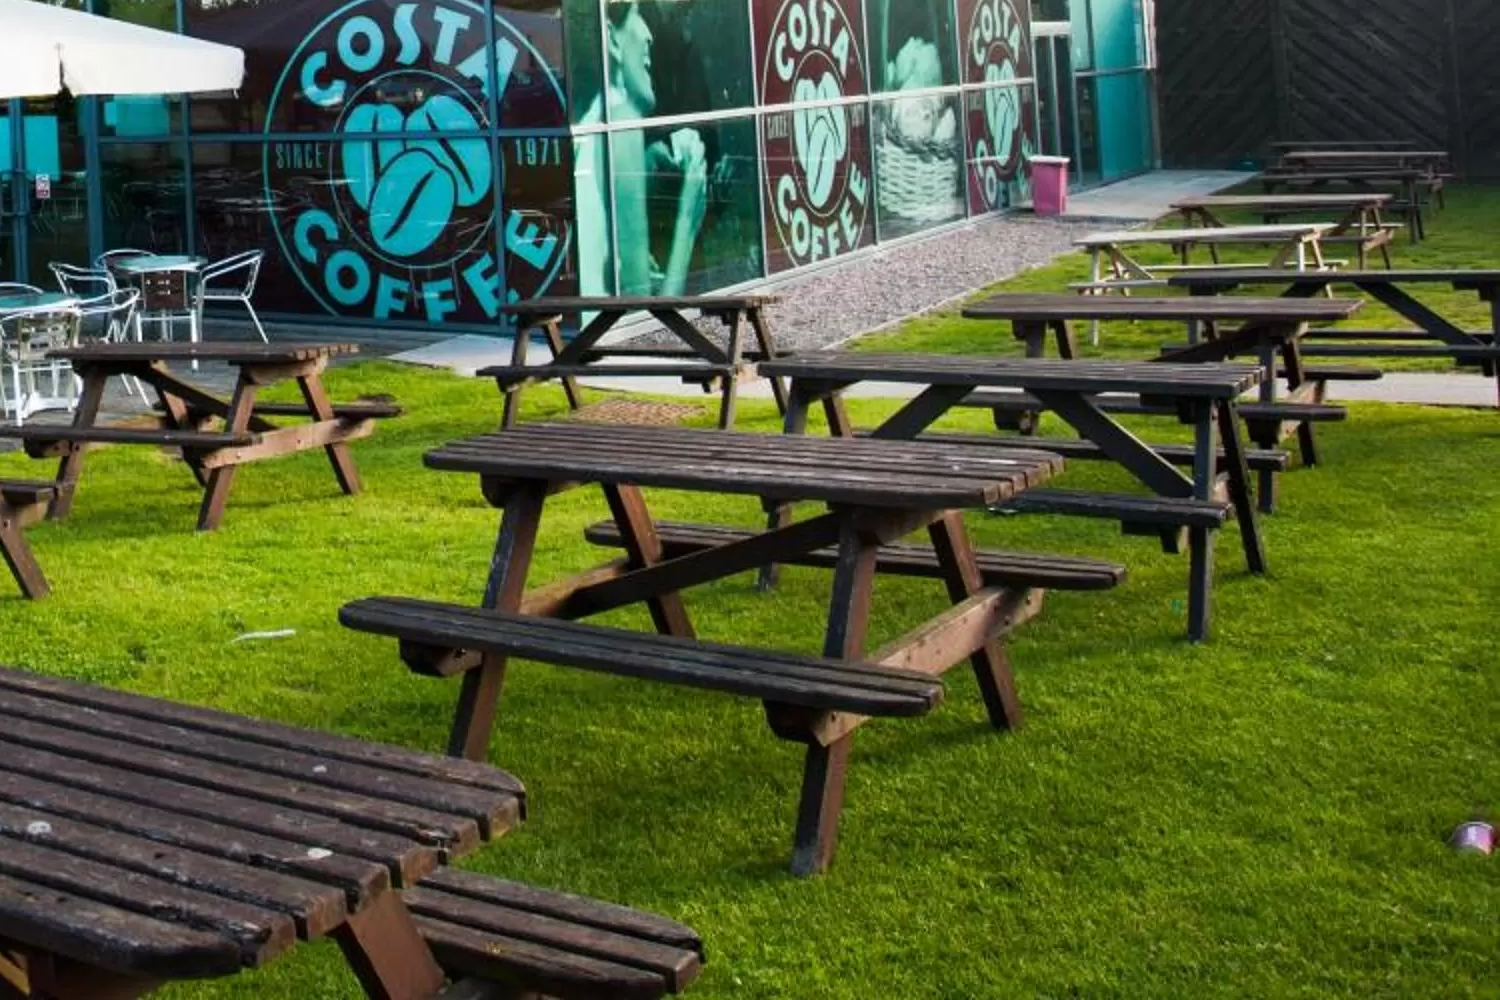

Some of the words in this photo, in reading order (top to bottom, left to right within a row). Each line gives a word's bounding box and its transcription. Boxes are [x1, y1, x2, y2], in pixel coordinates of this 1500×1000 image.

[301, 3, 519, 107] COSTA
[275, 141, 324, 169] SINCE
[514, 136, 562, 167] 1971
[777, 162, 868, 263] COFFEE
[294, 208, 557, 324] COFFEE
